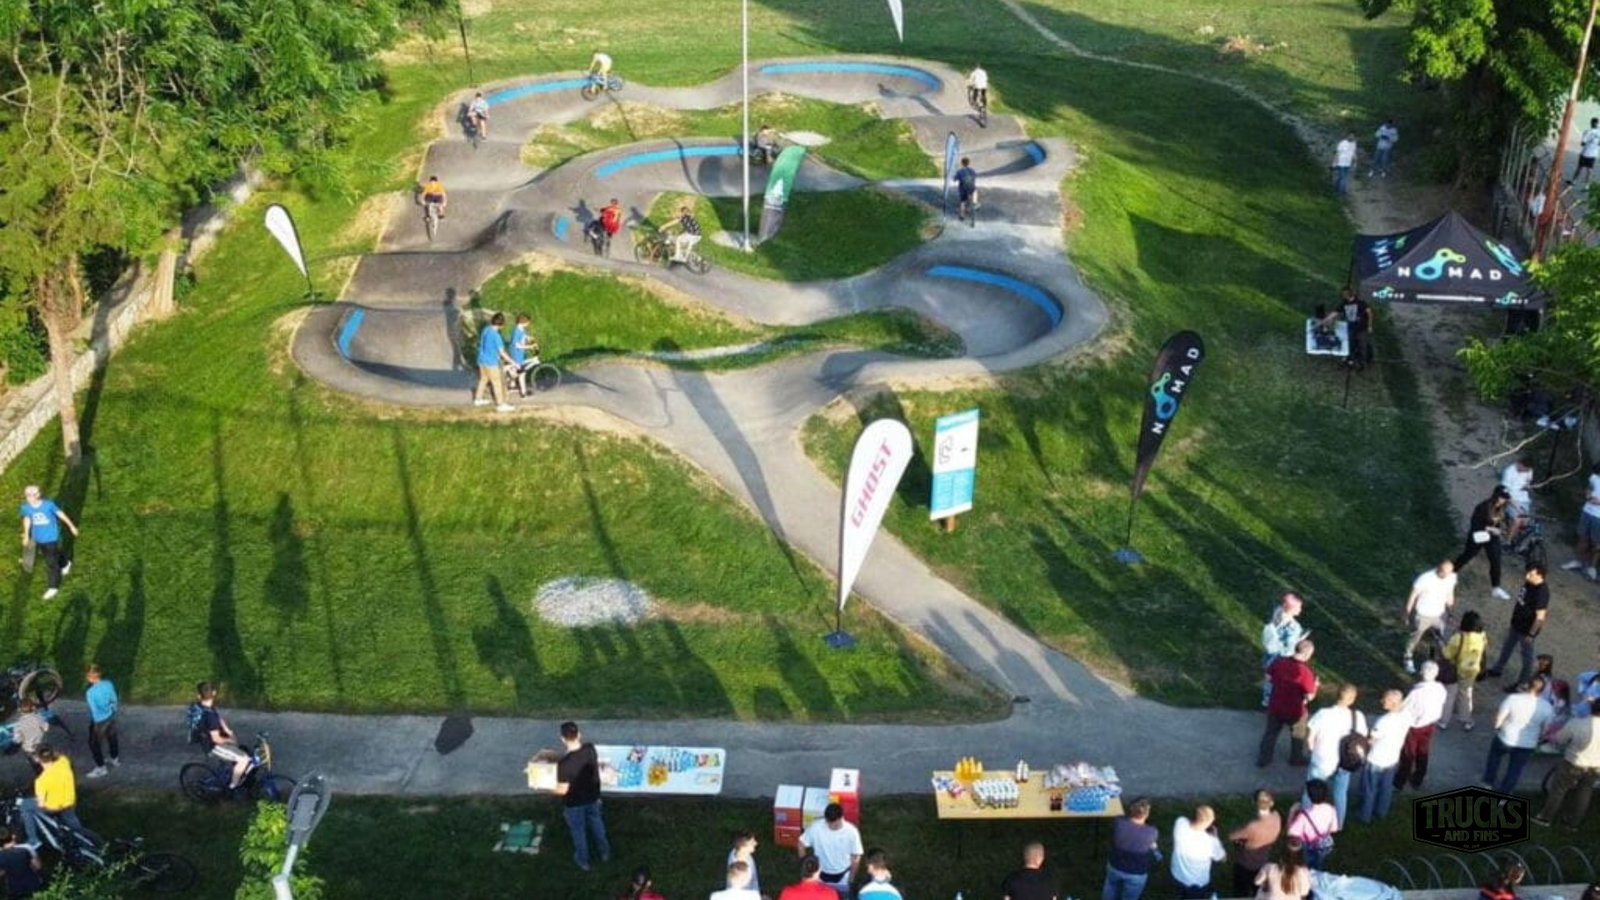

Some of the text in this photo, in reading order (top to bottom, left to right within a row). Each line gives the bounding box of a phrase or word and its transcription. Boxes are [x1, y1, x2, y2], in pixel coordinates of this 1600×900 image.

[1398, 248, 1502, 280] NOMAD
[1151, 347, 1201, 435] NOMAD
[851, 438, 893, 529] GHOST
